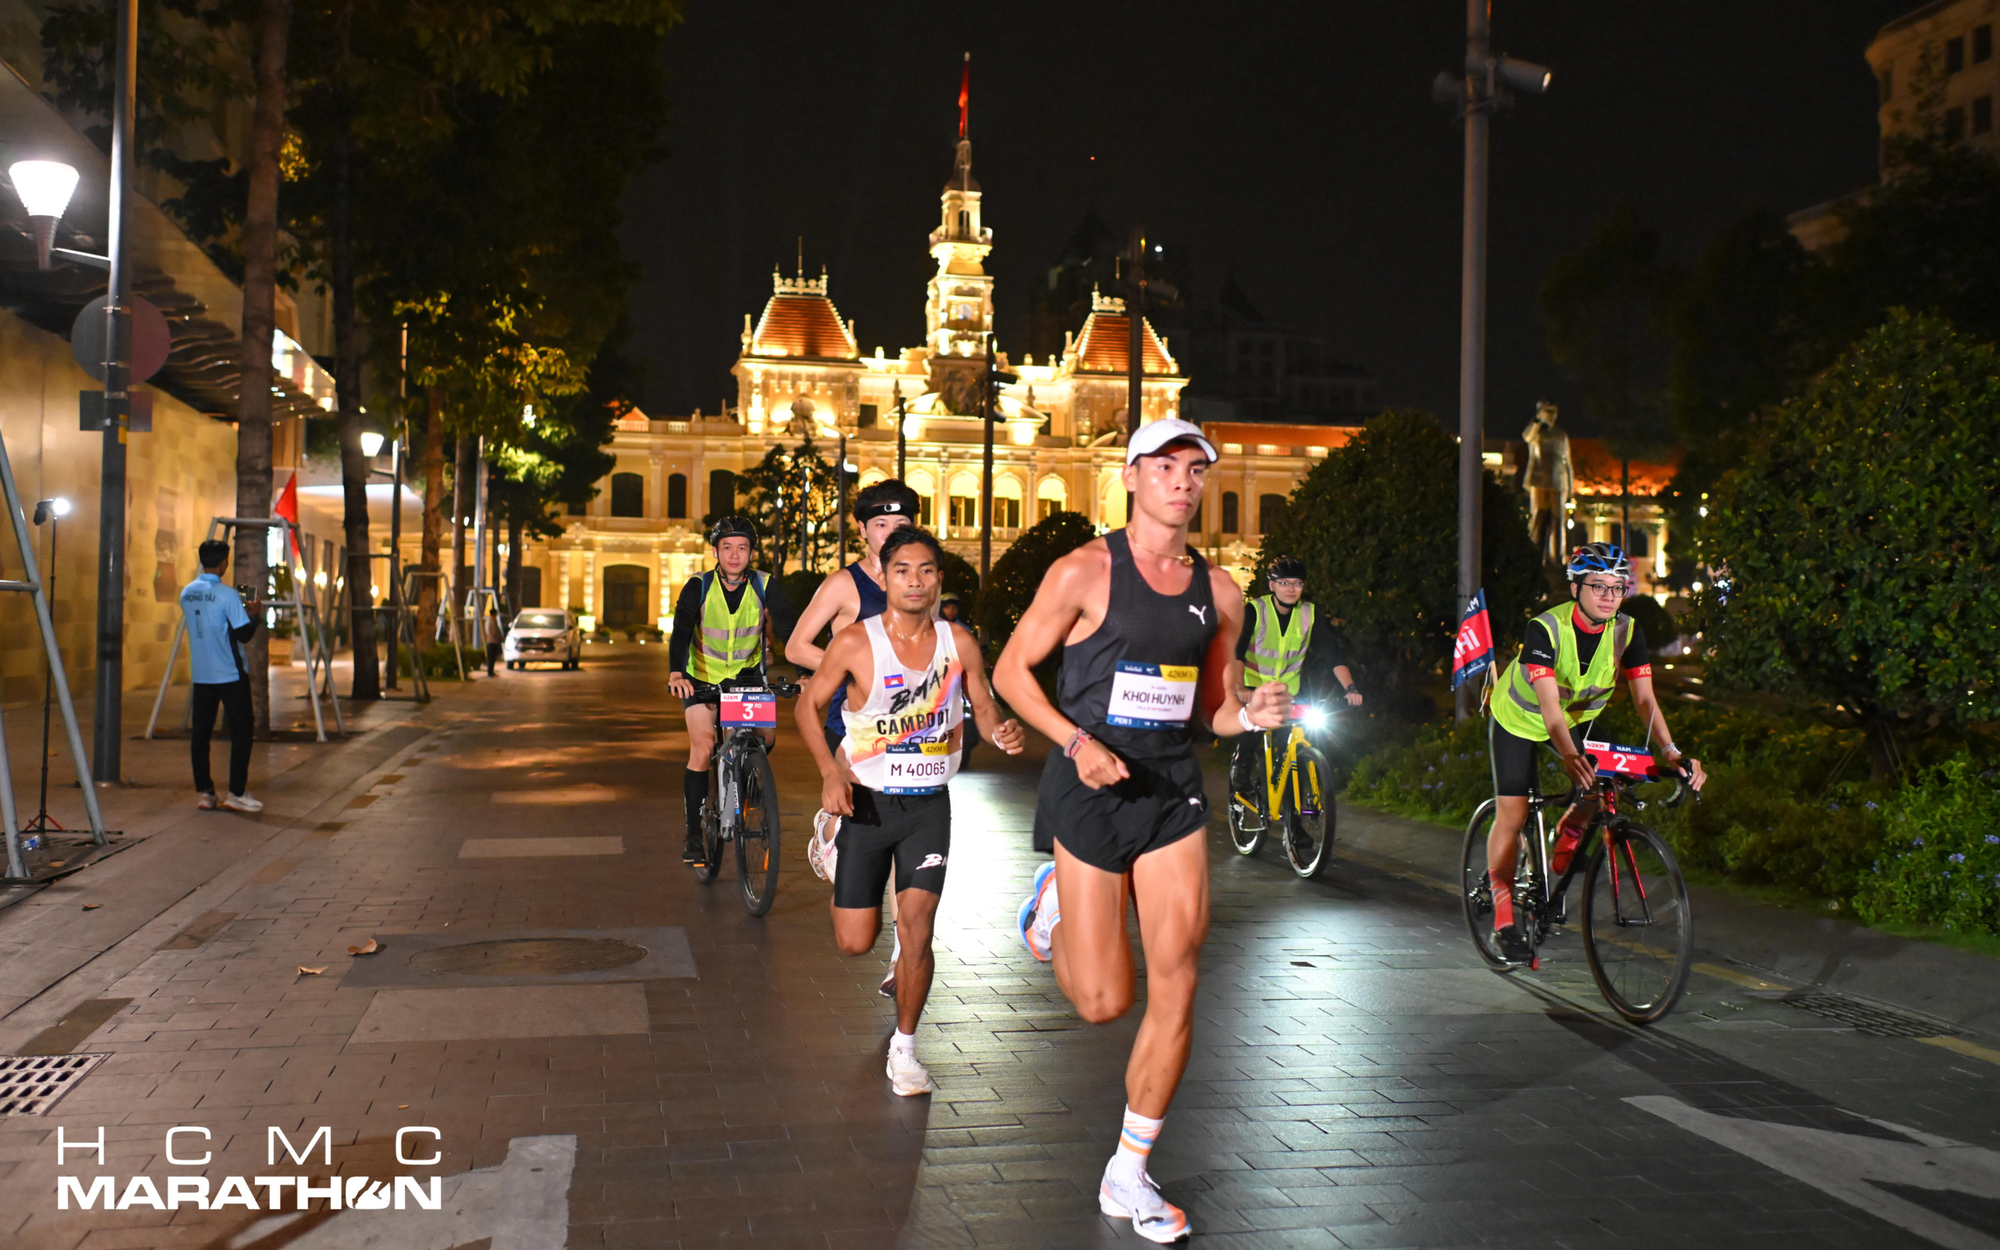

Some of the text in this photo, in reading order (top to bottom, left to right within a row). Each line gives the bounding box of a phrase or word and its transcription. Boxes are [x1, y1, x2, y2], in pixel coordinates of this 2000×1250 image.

[1122, 690, 1185, 706] KHOI HUYNH
[925, 746, 943, 754] 42KM
[1616, 745, 1631, 753] NAM
[891, 762, 946, 777] M 40065
